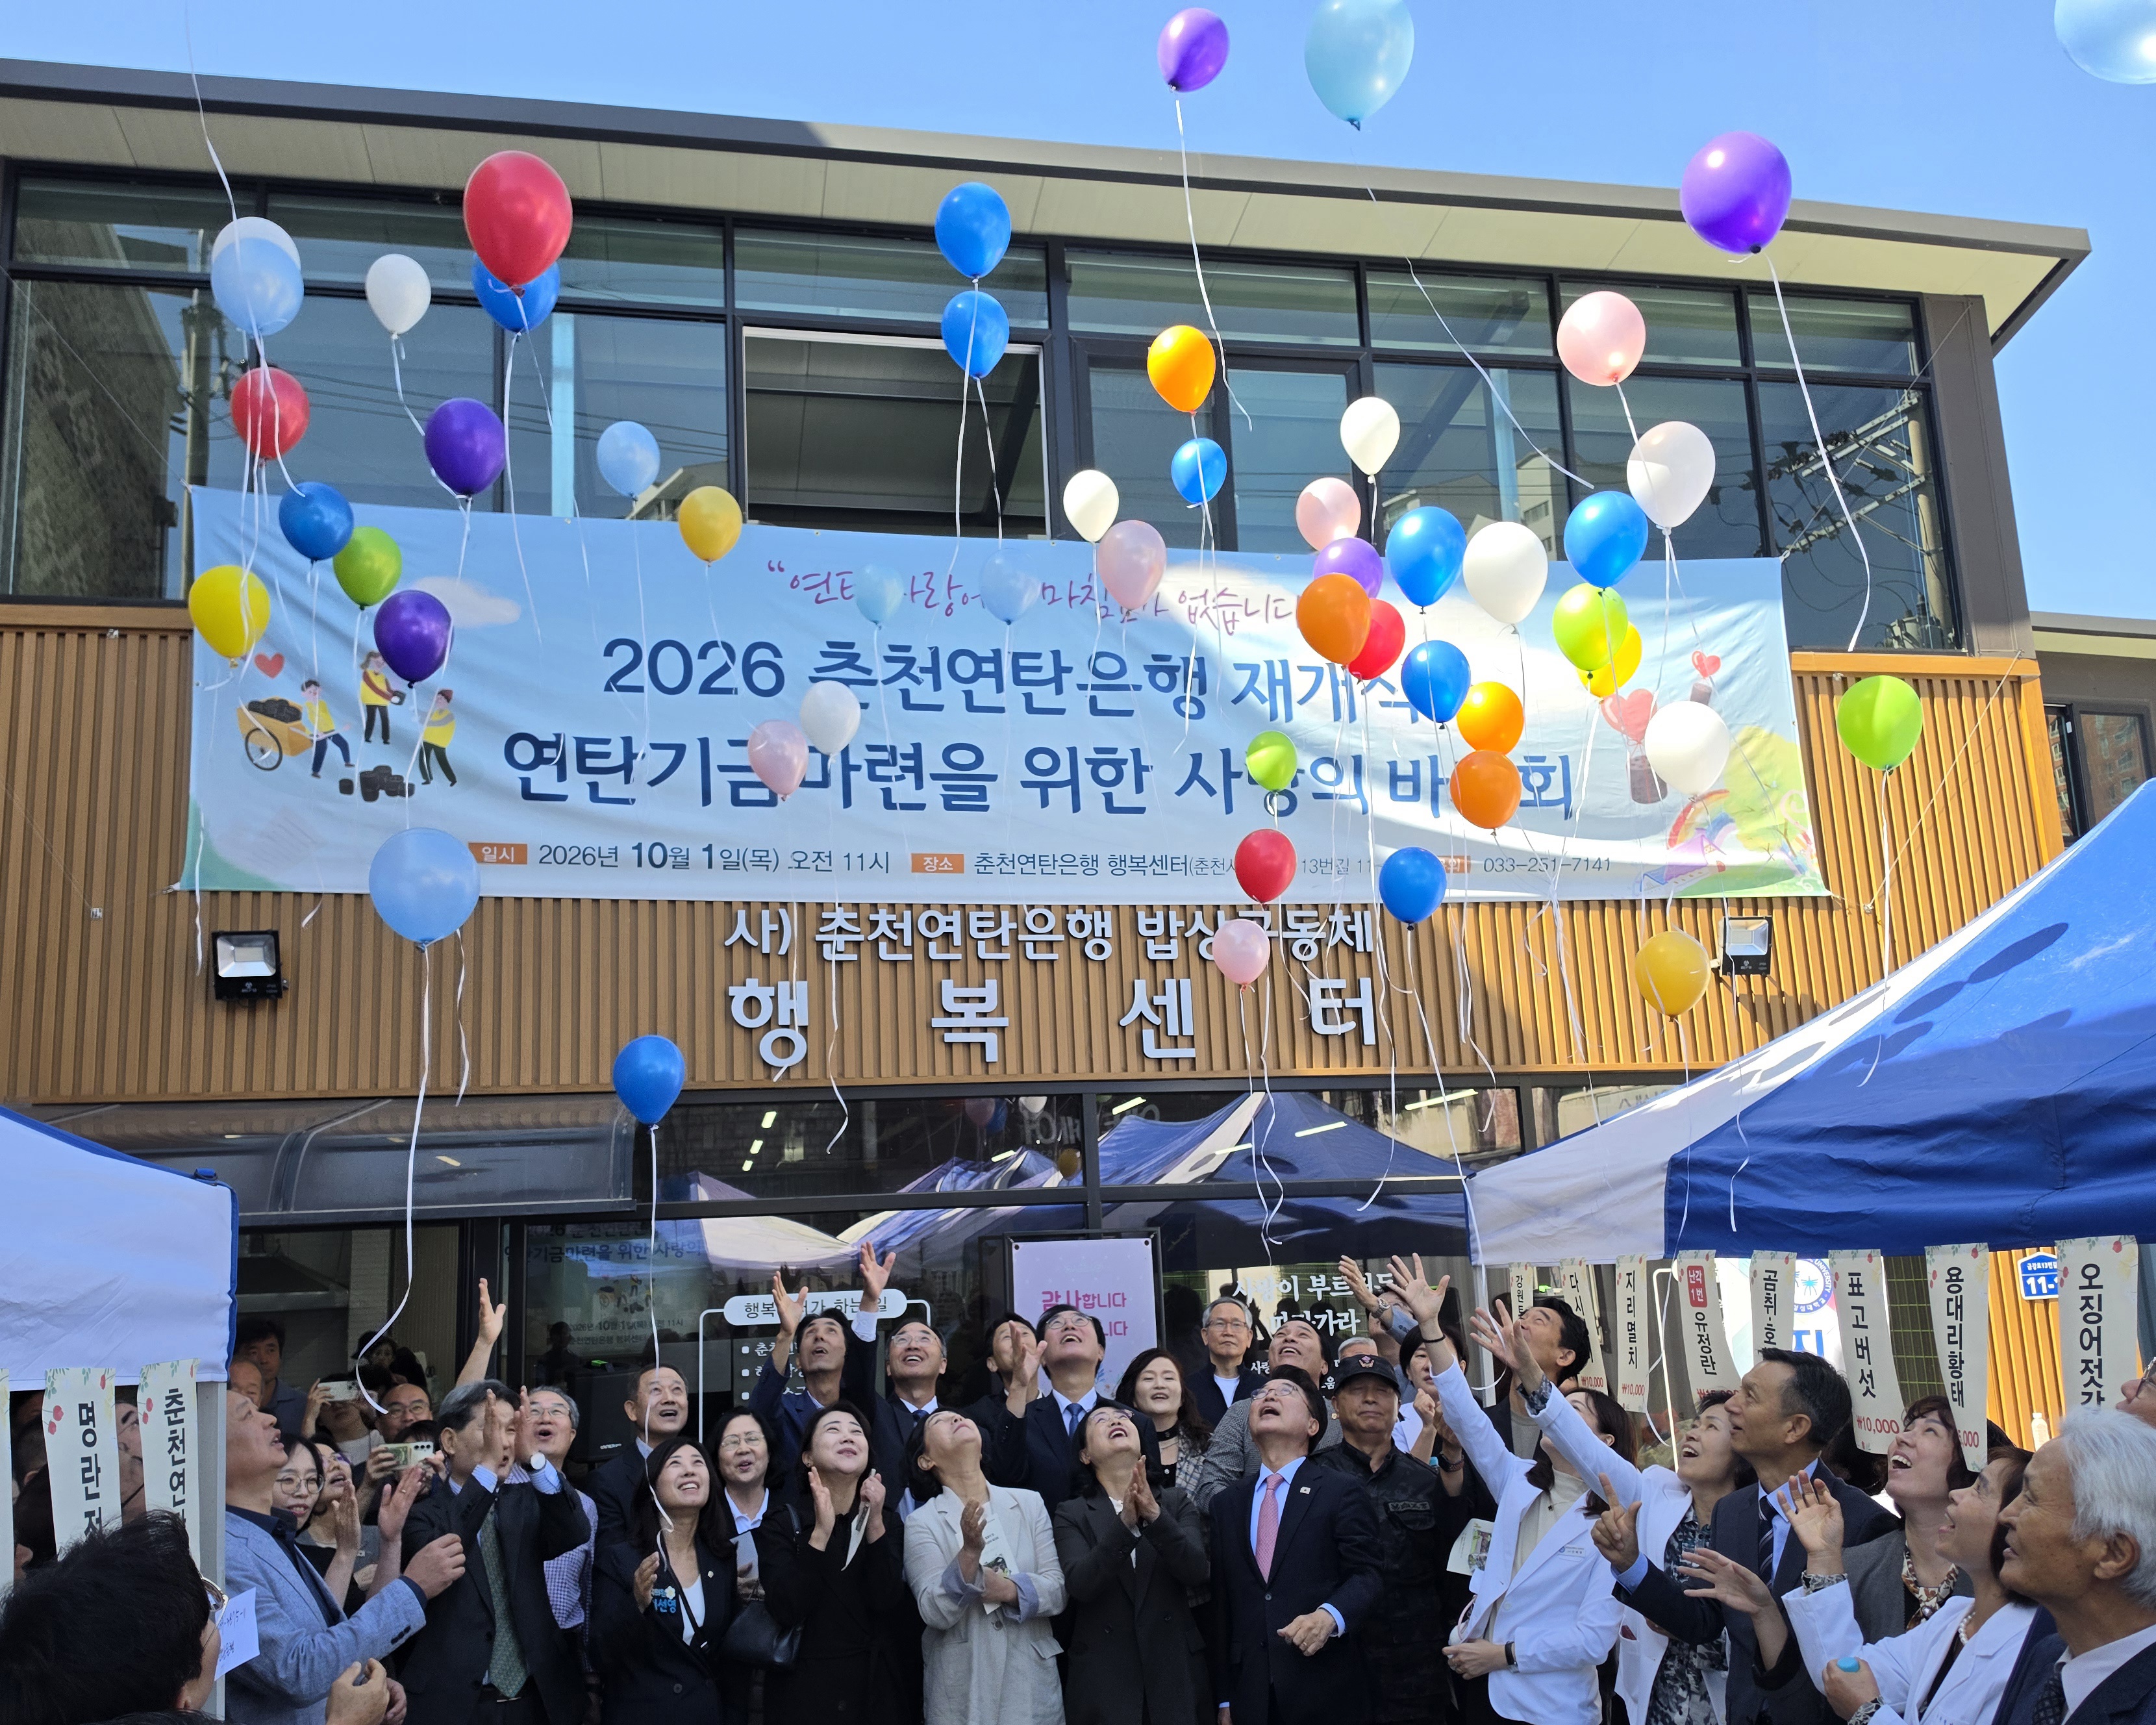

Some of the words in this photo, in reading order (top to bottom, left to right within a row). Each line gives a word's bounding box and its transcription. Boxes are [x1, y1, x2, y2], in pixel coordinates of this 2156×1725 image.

[603, 637, 786, 698] 2026
[503, 731, 999, 812] 연탄기금마련을
[1020, 746, 1154, 815] 위한
[1388, 754, 1574, 821] 바회
[481, 845, 516, 863] 일시
[538, 844, 619, 868] 2026년
[631, 841, 690, 870] 10월
[702, 842, 779, 874] 1일(목)
[788, 850, 834, 874] 오전
[843, 851, 890, 874] 11시
[923, 856, 954, 872] 장소
[974, 851, 1099, 876] 춘천연탄은행
[1483, 857, 1611, 873] 033-251-7141
[815, 906, 1113, 961] 춘천연탄은행
[505, 1244, 612, 1263] 기금마련을
[1814, 1259, 1832, 1293] UNIVERSITY
[1233, 1274, 1299, 1305] 사랑이
[1688, 1270, 1703, 1285] 난각
[1690, 1288, 1704, 1302] 1번
[744, 1300, 826, 1318] 행복가
[1625, 1270, 1638, 1369] 지리멸치
[1694, 1311, 1718, 1376] 유정란
[1848, 1272, 1876, 1398] 표고버섯
[1945, 1266, 1964, 1408] 용대리황태
[1857, 1415, 1899, 1435] ₩10,000
[164, 1387, 186, 1524] 춘천연
